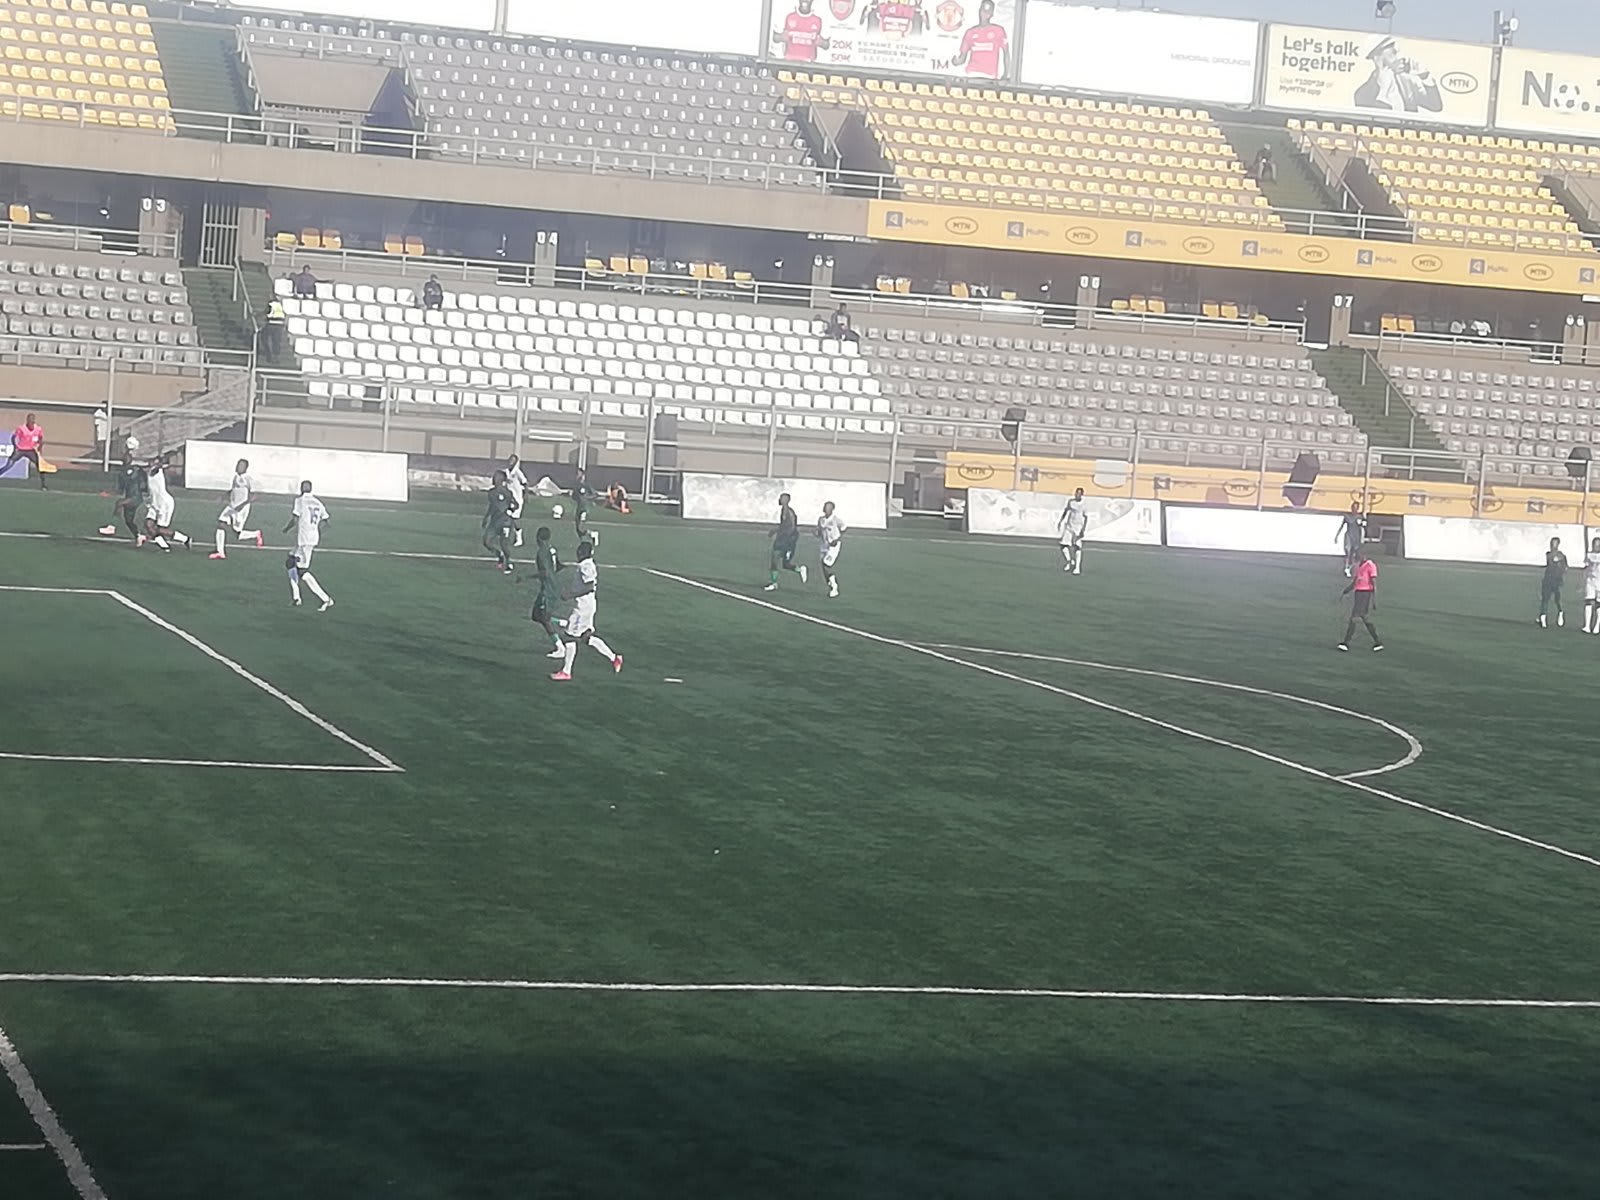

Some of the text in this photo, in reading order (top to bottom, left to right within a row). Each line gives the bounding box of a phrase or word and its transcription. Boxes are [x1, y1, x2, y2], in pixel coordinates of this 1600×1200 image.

[832, 39, 852, 50] 20K
[1283, 35, 1359, 57] Let's talk
[858, 47, 897, 56] DECEMBER
[931, 59, 949, 70] 1M
[1282, 52, 1355, 72] together
[1449, 78, 1470, 88] MTN
[905, 217, 928, 227] MoMo
[952, 221, 971, 230] MTN
[1073, 231, 1091, 240] MTN
[1190, 241, 1208, 250] MTN
[1305, 249, 1323, 258] MTN
[1419, 258, 1437, 267] MTN
[1530, 267, 1548, 276] MTN
[1334, 295, 1354, 308] 07
